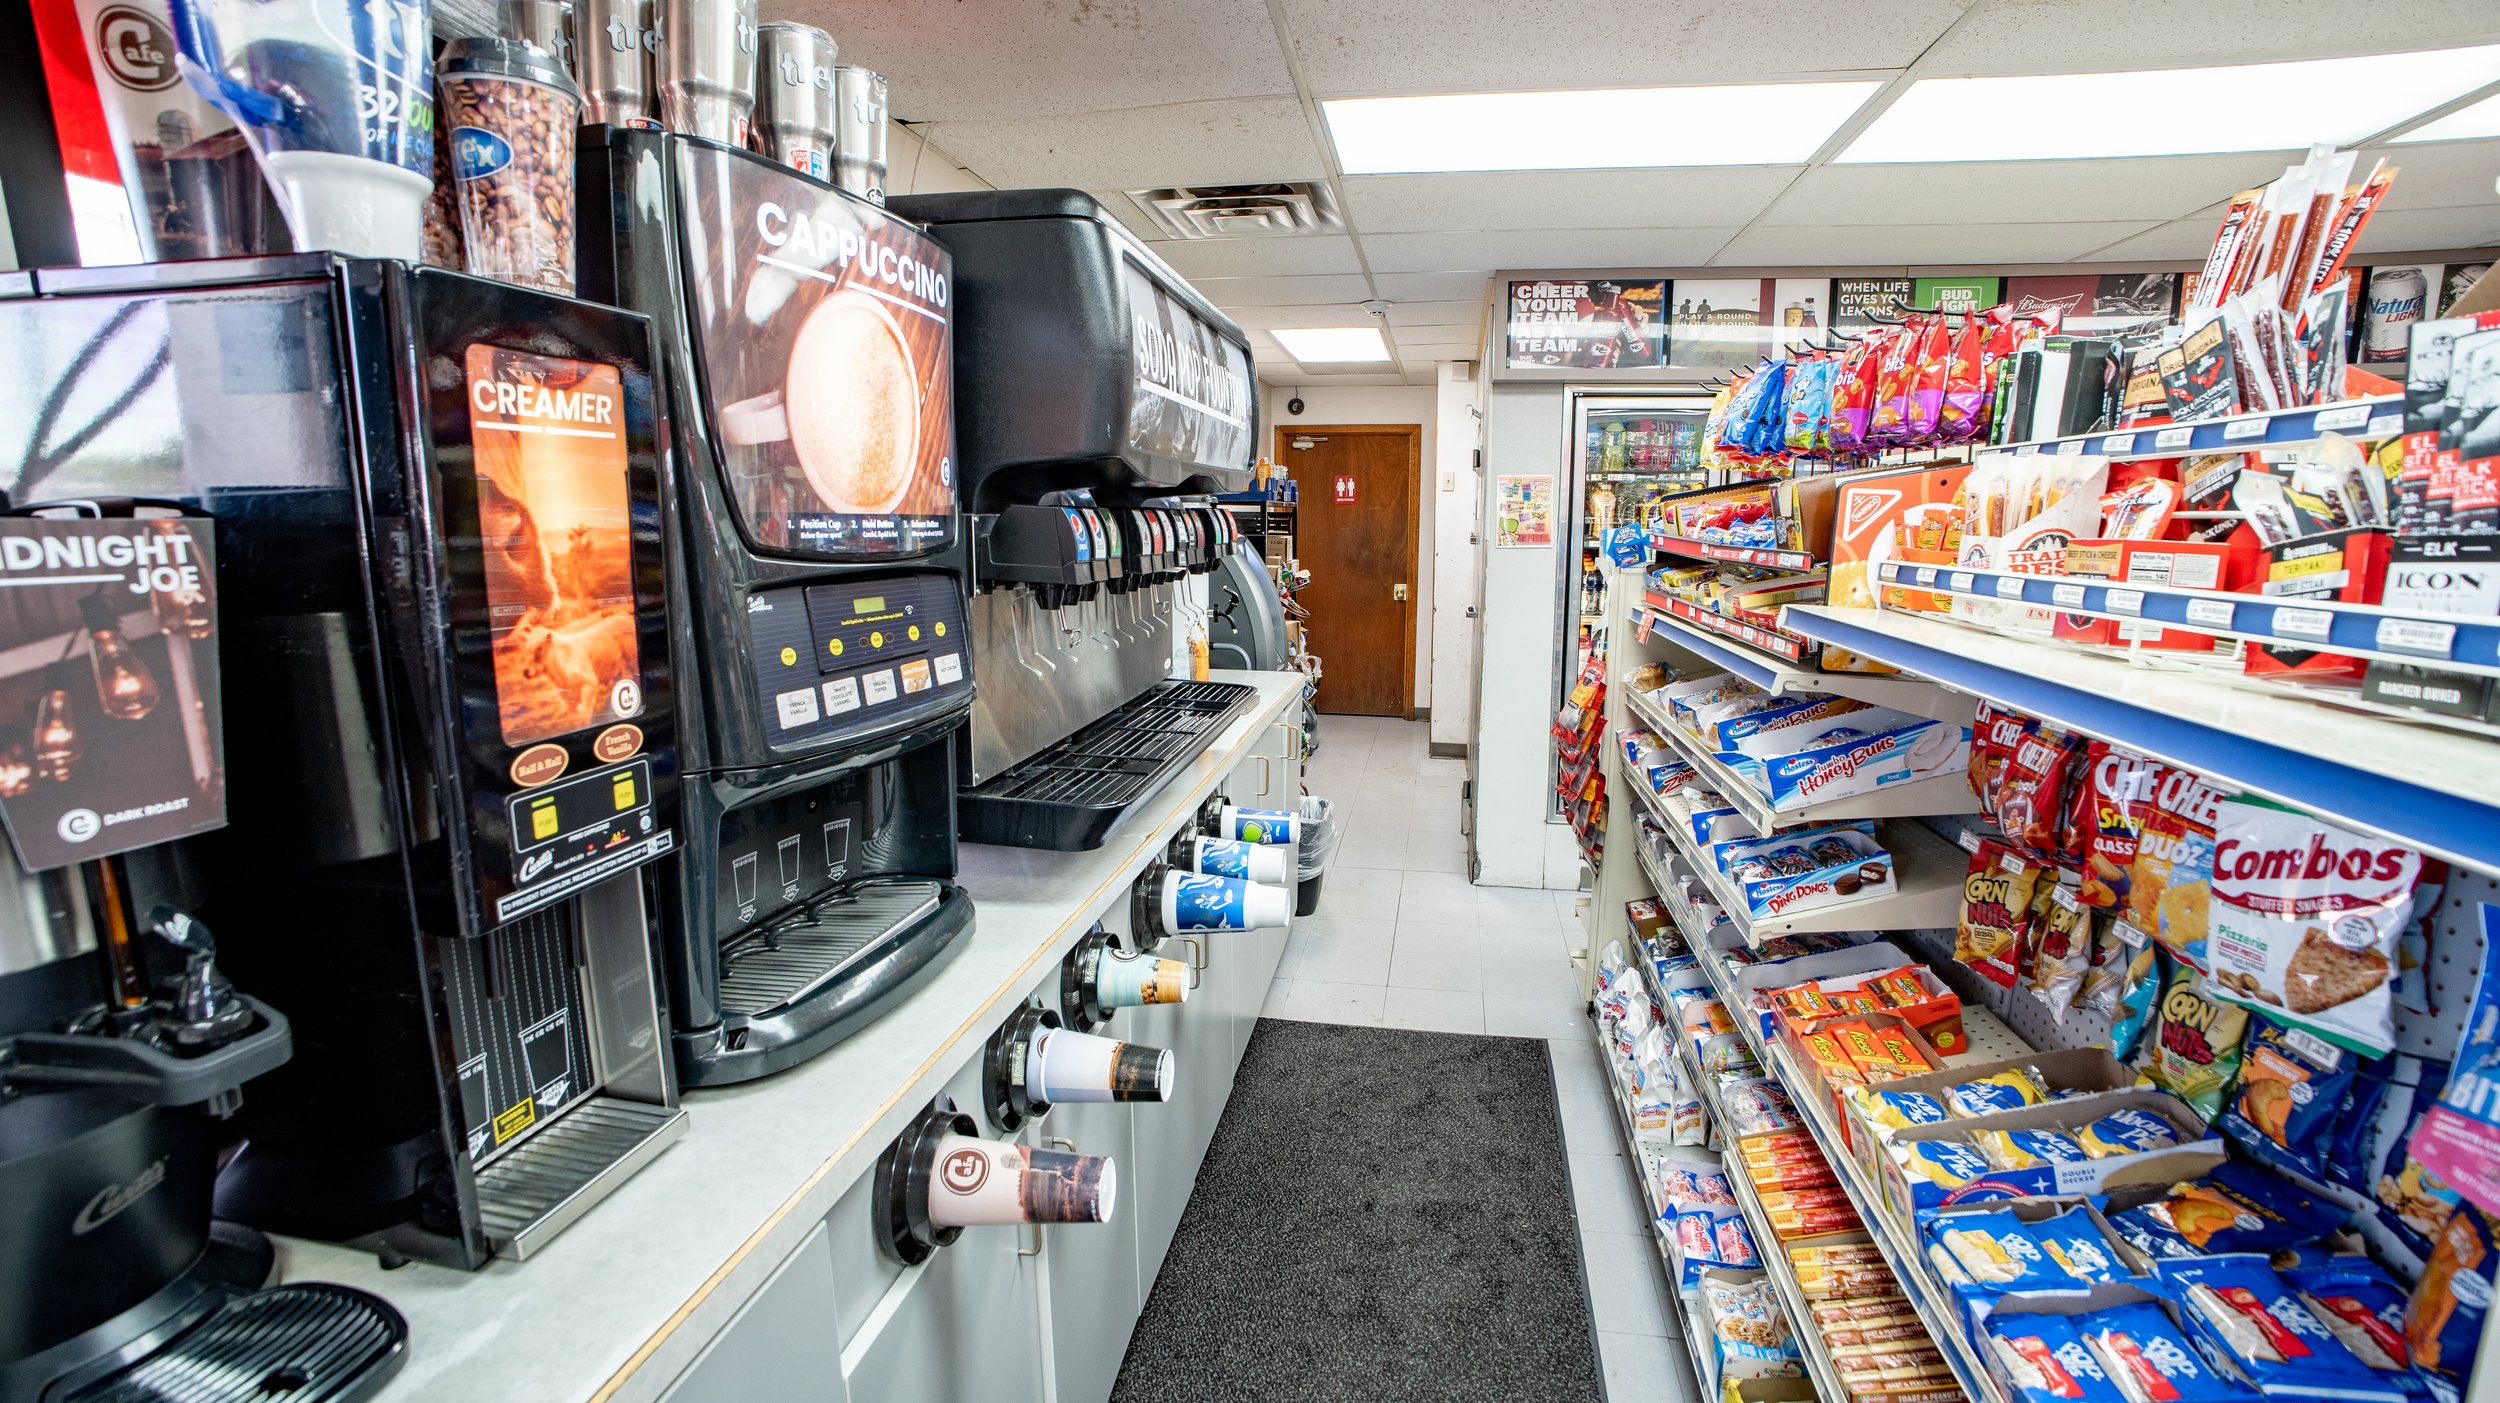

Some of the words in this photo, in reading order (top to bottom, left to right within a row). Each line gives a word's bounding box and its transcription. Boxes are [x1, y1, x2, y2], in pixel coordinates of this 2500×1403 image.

[356, 84, 401, 123] 32
[757, 201, 948, 309] CAPPUCCINO
[1517, 285, 1589, 298] CHEER
[1841, 282, 1880, 293] WHEN
[1884, 282, 1910, 292] LIFE
[1941, 289, 1973, 300] BUD
[1517, 299, 1577, 312] YOUR
[1840, 294, 1878, 305] GIVES
[1880, 293, 1908, 304] YOU
[2016, 297, 2076, 316] Budweiser
[1840, 306, 1897, 319] LEMONS,
[2384, 309, 2423, 323] LIGHT
[1516, 325, 1546, 338] AS
[1549, 325, 1565, 338] A
[1516, 339, 1582, 352] TEAM.
[2187, 335, 2219, 360] ORIGINAL
[1136, 314, 1178, 393] SODA
[1177, 340, 1201, 403] POP
[1203, 354, 1248, 428] FOUNTAIN
[1884, 352, 1906, 374] bits
[1835, 370, 1857, 386] bits
[473, 378, 613, 424] CREAMER
[2192, 455, 2223, 477] ORIGINAL
[1851, 494, 1880, 521] NABISCO
[787, 519, 795, 529] 1.
[800, 519, 828, 529] Position
[829, 519, 841, 531] Cup
[851, 520, 858, 529] 2.
[862, 519, 876, 528] Hold
[2423, 541, 2458, 557] ELK
[129, 565, 201, 594] JOE
[2397, 570, 2481, 591] ICON
[2027, 606, 2051, 620] USA
[789, 700, 806, 709] FRENCH
[790, 707, 807, 716] VANILLA
[1787, 702, 1828, 725] Buns
[1732, 719, 1758, 733] Hostess
[604, 732, 631, 745] French
[606, 743, 633, 757] Vanilla
[518, 763, 537, 777] Half
[537, 761, 544, 771] &
[544, 756, 563, 769] Half
[1783, 759, 1815, 775] Hostess
[1798, 757, 1855, 797] Honey
[1850, 735, 1896, 767] Buns
[1815, 755, 1846, 775] Jumbo
[103, 806, 142, 826] DARK
[144, 797, 190, 816] ROAST
[2139, 832, 2204, 867] DUOZ
[2214, 830, 2405, 882] Combos
[502, 902, 511, 913] TO
[511, 889, 539, 911] PREVENT
[572, 869, 597, 883] RELEASE
[596, 860, 618, 874] BUTTON
[617, 854, 630, 866] WHEN
[629, 849, 642, 860] CUP
[656, 837, 669, 847] FULL
[1753, 882, 1786, 899] Hostess
[1964, 871, 2009, 904] CORN
[1768, 887, 1796, 915] DING
[1796, 880, 1829, 902] DONGS
[2248, 893, 2294, 914] STUFFED
[2295, 894, 2344, 914] SNACKS
[1967, 902, 2013, 928] NUTS
[1975, 930, 1995, 939] BBQ
[2218, 923, 2268, 951] Pizzeria
[2164, 981, 2217, 1029] CORN
[1813, 1035, 1840, 1063] Reese's
[1849, 1030, 1878, 1056] Reese's
[1883, 1039, 1912, 1065] Reese's
[1013, 1043, 1027, 1085] MODULAR
[1938, 1152, 1973, 1181] Pie
[2062, 1168, 2097, 1177] DOUBLE
[1954, 1183, 1983, 1195] ORIGINAL
[2063, 1175, 2096, 1185] DECKER
[1930, 1392, 1957, 1403] PEANUT
